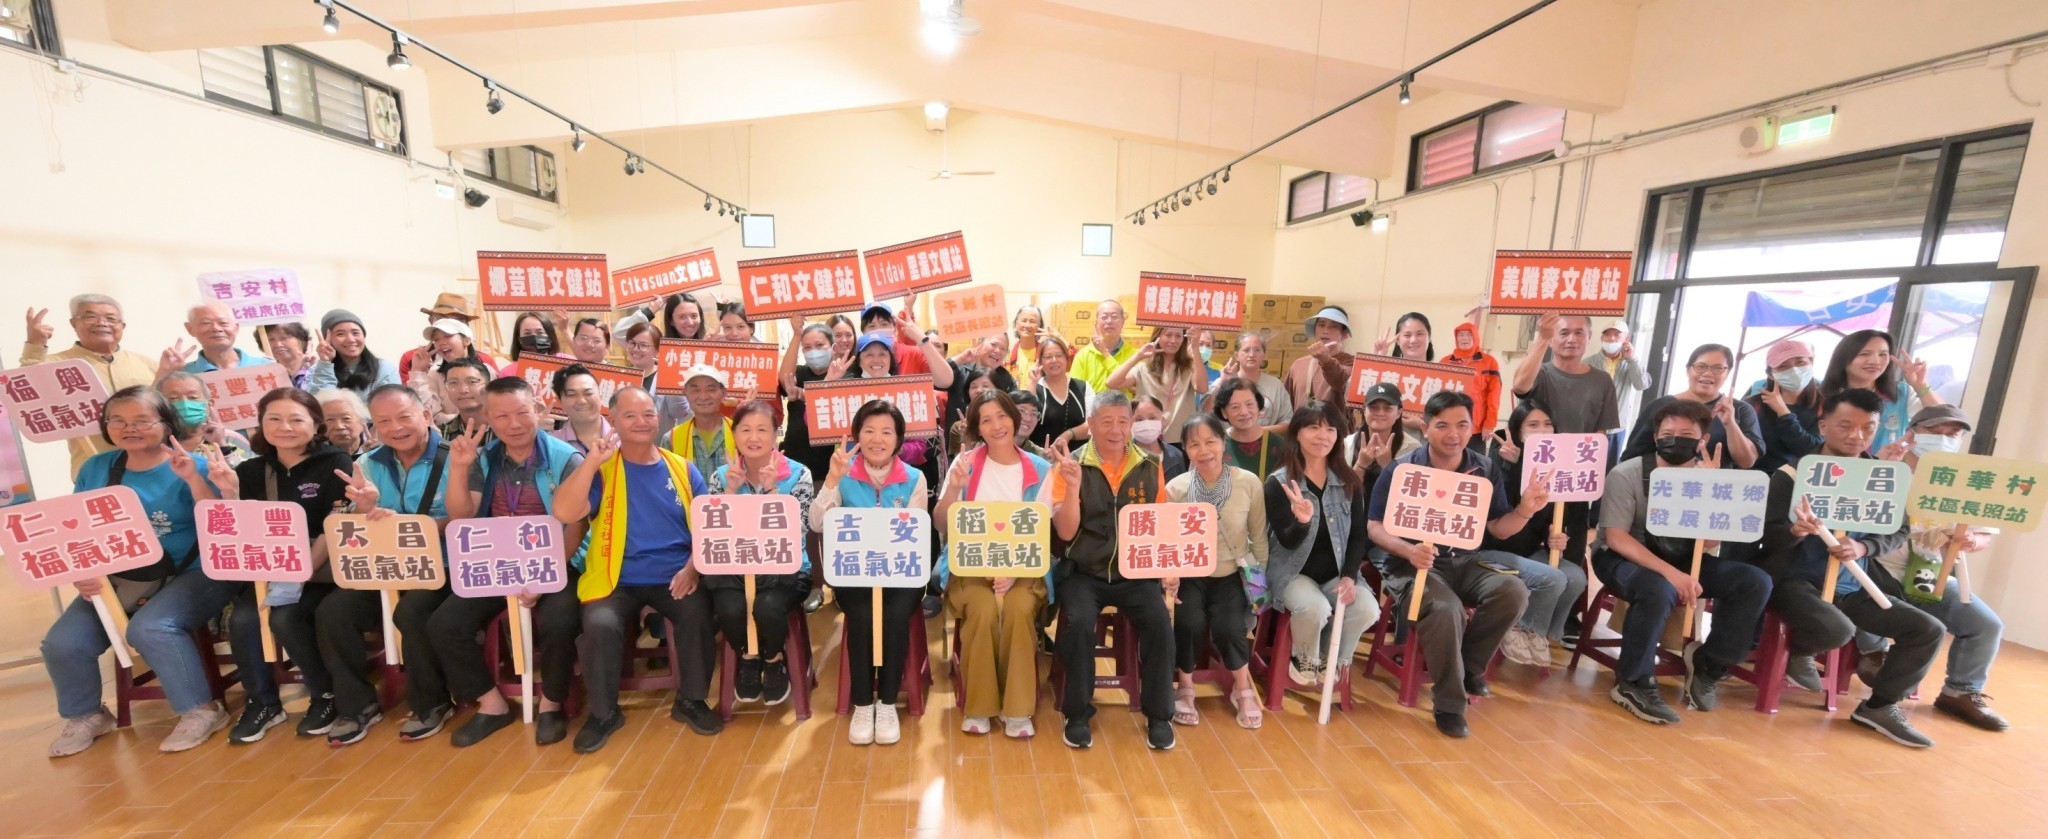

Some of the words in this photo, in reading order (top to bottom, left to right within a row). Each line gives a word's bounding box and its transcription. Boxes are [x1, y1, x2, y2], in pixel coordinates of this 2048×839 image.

[212, 277, 288, 300] 吉安村
[749, 265, 857, 307] 仁和文健站
[873, 260, 906, 286] Lidaw
[1500, 265, 1622, 301] 美雅麥文健站
[1144, 284, 1239, 320] 博愛新村文健站
[4, 366, 91, 403] 福興
[20, 398, 104, 435] 福氣站
[1532, 439, 1599, 465] 永安
[1401, 469, 1481, 509] 東昌
[1652, 478, 1766, 503] 光華城鄉
[1806, 462, 1897, 493] 北昌
[1928, 465, 2038, 497] 南華村
[6, 494, 131, 544] 仁里
[207, 503, 296, 538] 慶豐
[702, 498, 789, 531] 宜昌
[957, 507, 1040, 536] 稻香
[1128, 508, 1207, 538] 勝安
[1393, 501, 1479, 542] 福氣站
[1649, 508, 1763, 533] 發展協會
[1917, 494, 2029, 525] 社區長照站
[456, 522, 551, 553] 仁和
[835, 512, 920, 543] 吉安
[21, 529, 151, 579] 福氣站
[208, 542, 302, 574] 福氣站
[701, 536, 794, 566] 福氣站
[832, 549, 923, 578] 福氣站
[955, 541, 1043, 570] 福氣站
[1127, 541, 1210, 570] 福氣站
[339, 555, 436, 581] 福氣站
[458, 557, 558, 587] 福氣站
